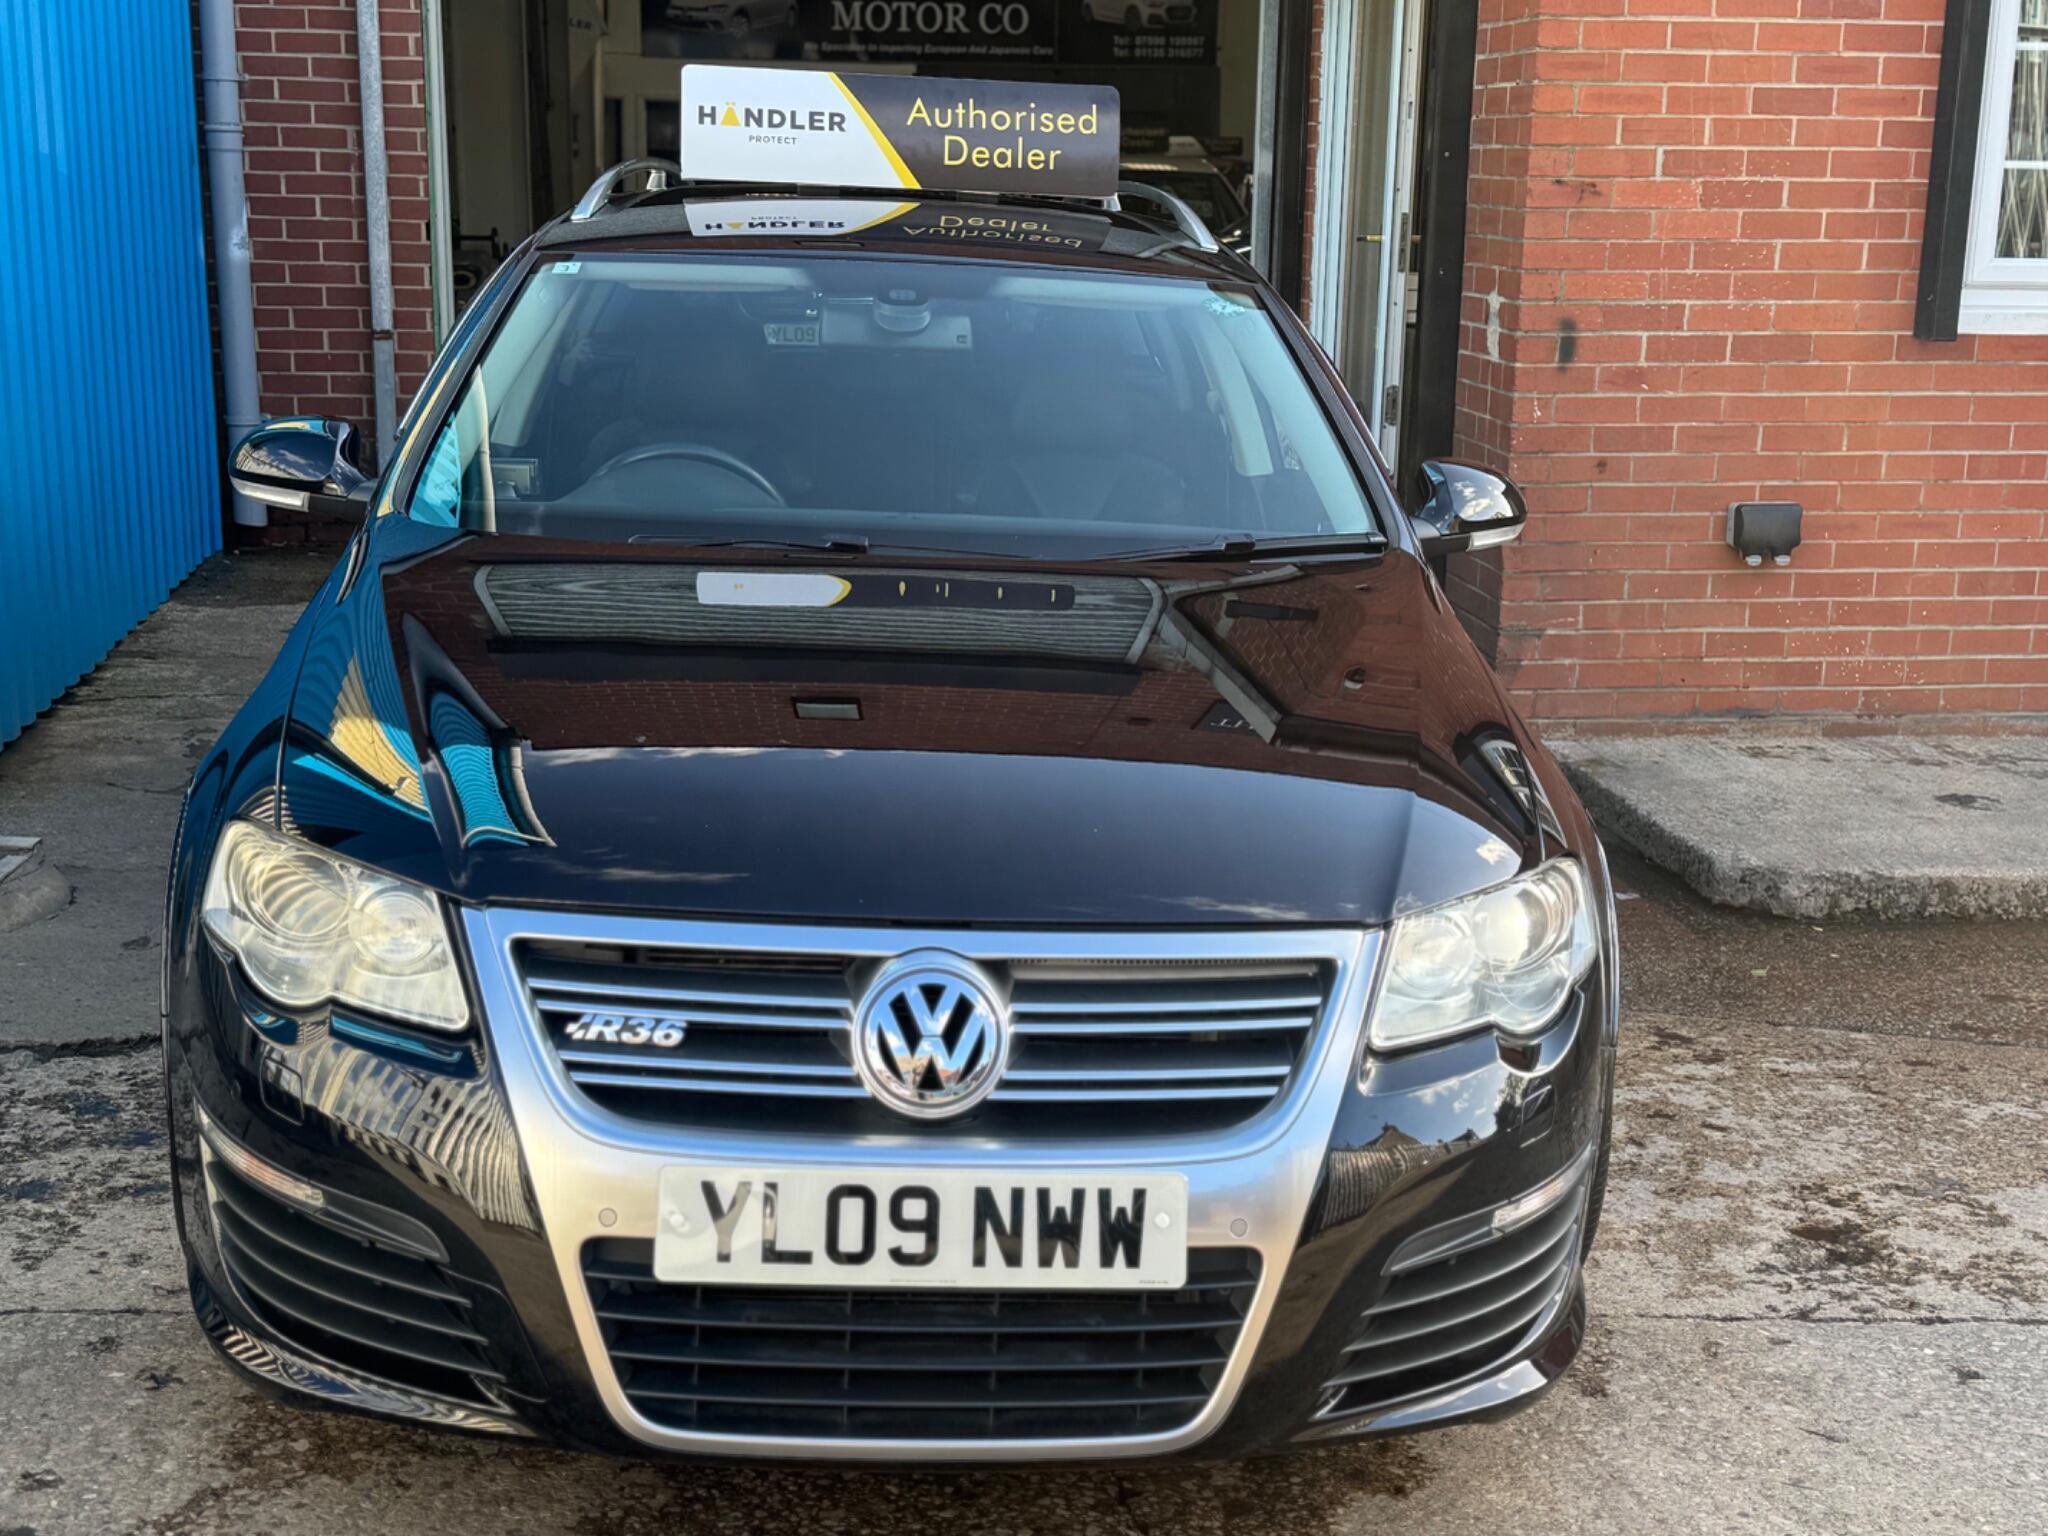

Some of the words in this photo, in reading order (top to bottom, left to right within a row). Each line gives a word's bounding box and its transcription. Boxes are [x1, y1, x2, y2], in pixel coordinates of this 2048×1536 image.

[831, 1, 971, 33] MOTOR
[979, 3, 1029, 35] CO
[906, 97, 1098, 135] Authorised
[749, 135, 797, 145] PROTECT
[944, 135, 1062, 170] Dealer
[700, 1180, 941, 1267] YL09
[972, 1186, 1147, 1269] NWW
